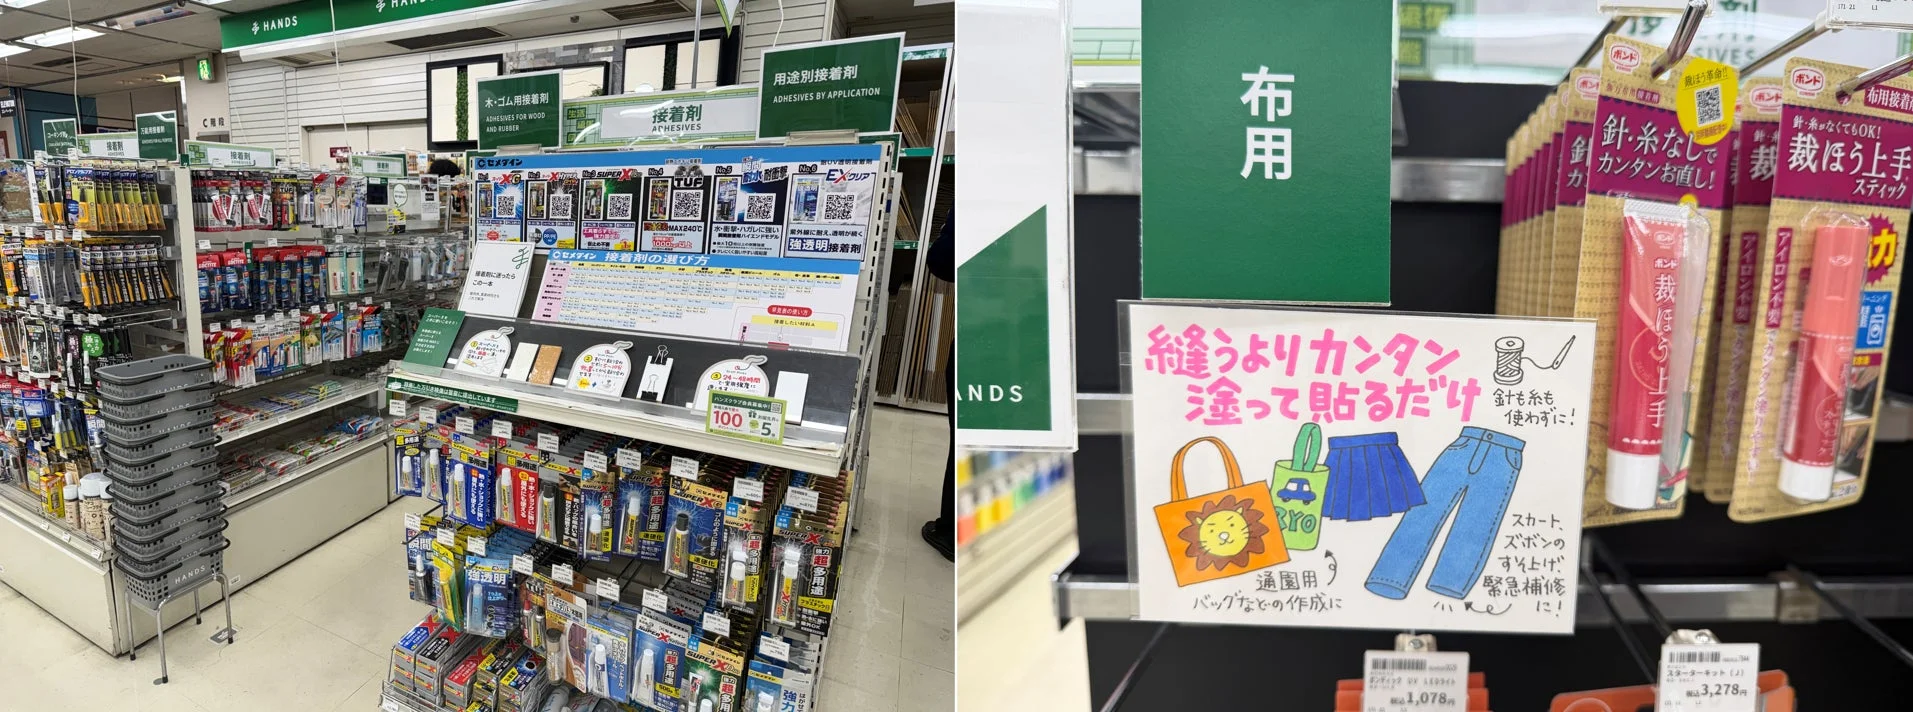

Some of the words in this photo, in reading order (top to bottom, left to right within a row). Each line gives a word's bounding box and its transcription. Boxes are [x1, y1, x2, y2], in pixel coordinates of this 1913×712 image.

[263, 15, 298, 31] HANDS
[1612, 49, 1637, 62] ボンド
[773, 65, 858, 86] 用途別接着剤
[1794, 73, 1822, 86] ボンド
[485, 92, 548, 108] 木・ゴム用接着剤
[773, 92, 815, 103] ADHESIVES
[816, 91, 826, 100] BY
[827, 87, 881, 100] APPLICATION
[486, 114, 515, 122] ADHESIVES
[652, 104, 702, 123] 接着剤
[498, 124, 520, 132] RUBBER
[652, 123, 702, 132] ADHESIVES
[1240, 65, 1294, 181] 布用
[1601, 113, 1718, 165] 針・糸なしで
[487, 158, 523, 167] セメダイン
[1787, 132, 1912, 182] 裁ほう上手
[1597, 153, 1716, 190] カンタンお直し!
[674, 177, 704, 188] TUF
[1852, 178, 1907, 200] スティック
[1868, 228, 1898, 269] 力
[561, 252, 597, 260] セメダイン
[605, 252, 711, 266] 接着剤の選び方
[472, 279, 494, 287] この一本
[475, 270, 516, 280] 接着剤に迷ったら
[1767, 230, 1791, 326] アイロン不要
[1145, 323, 1460, 379] 縫うよりカンタン
[1185, 375, 1482, 425] 塗って貼るだけ
[1493, 387, 1554, 407] 針も糸も
[713, 410, 743, 428] 100
[1504, 406, 1576, 427] 使わずに!
[1504, 533, 1565, 550] ズボンの
[175, 565, 206, 584] HANDS
[468, 570, 507, 585] 強透明
[1256, 570, 1318, 592] 通園用
[1483, 575, 1566, 598] 緊急補修
[1193, 589, 1343, 613] バッグなどの作成に
[1536, 601, 1563, 617] に!
[1666, 669, 1726, 677] スターターキット
